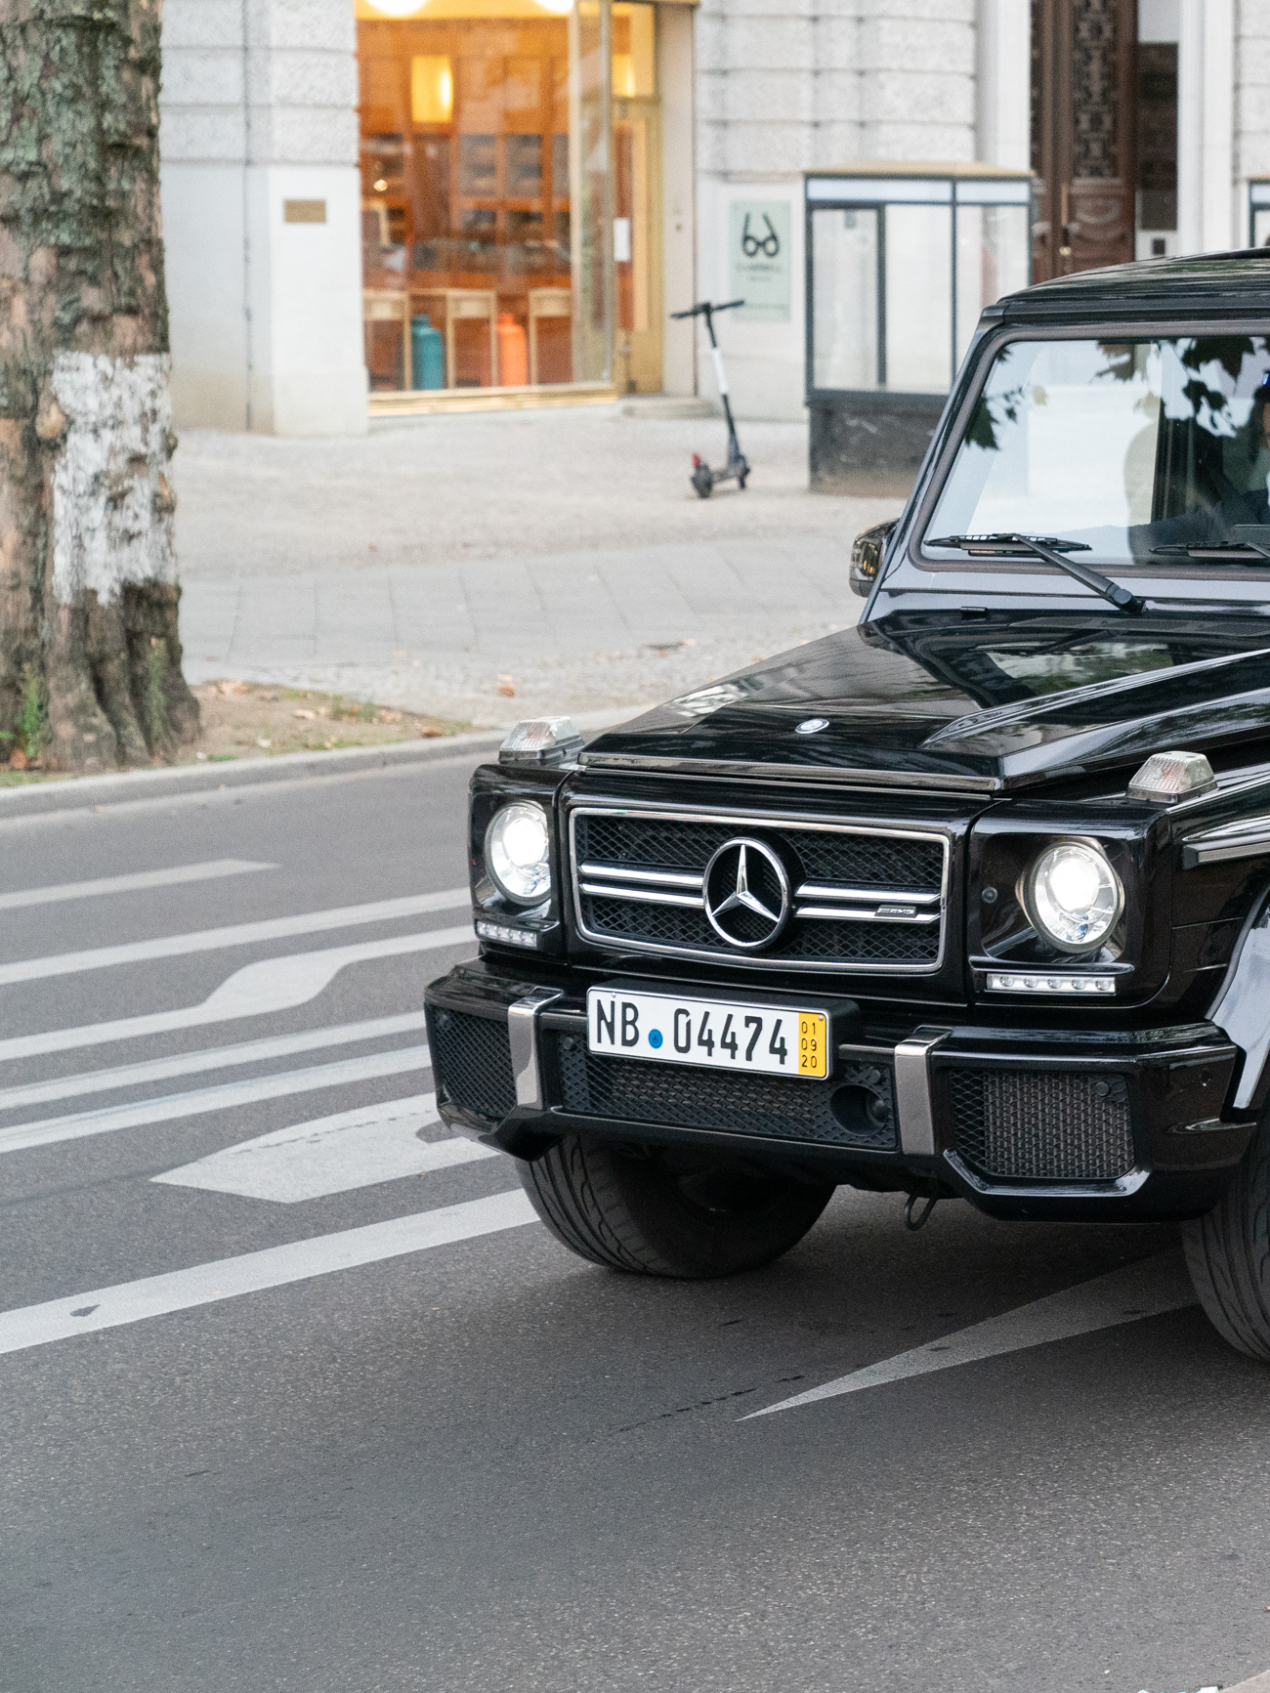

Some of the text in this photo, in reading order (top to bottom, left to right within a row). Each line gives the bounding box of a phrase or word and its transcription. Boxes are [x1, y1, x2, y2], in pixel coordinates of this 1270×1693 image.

[597, 999, 788, 1065] NB 04474
[802, 1021, 816, 1035] 01
[802, 1037, 817, 1052] 09
[802, 1054, 817, 1069] 20
